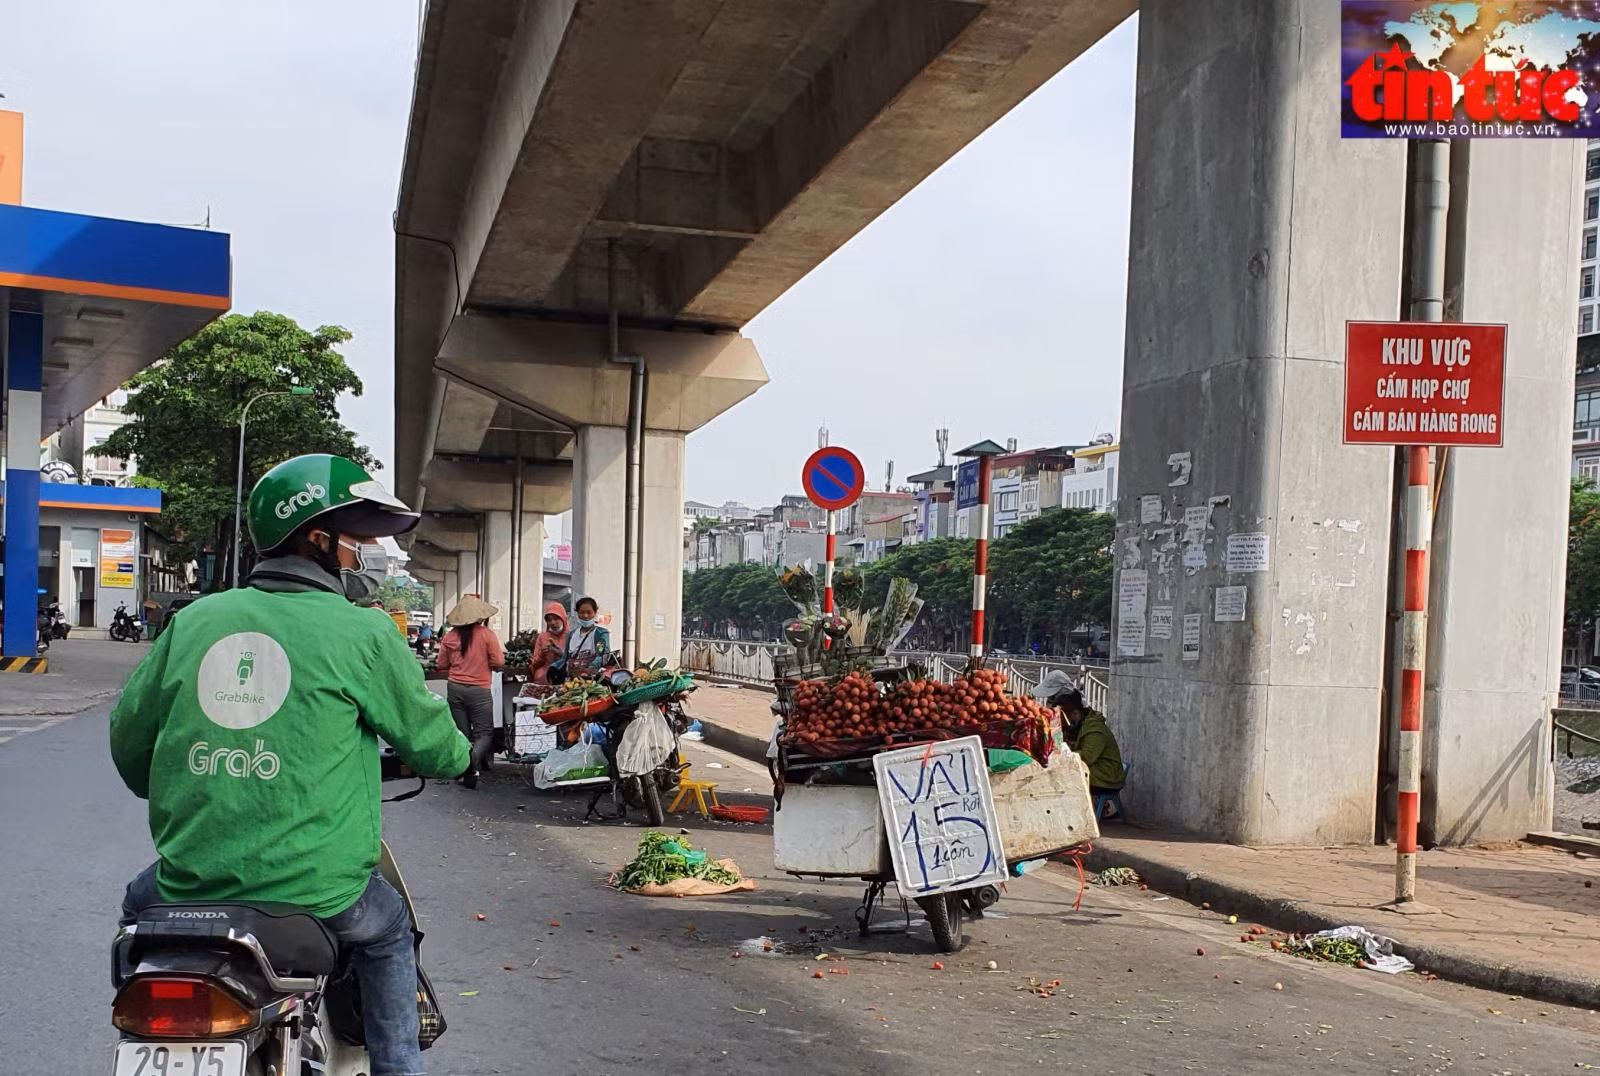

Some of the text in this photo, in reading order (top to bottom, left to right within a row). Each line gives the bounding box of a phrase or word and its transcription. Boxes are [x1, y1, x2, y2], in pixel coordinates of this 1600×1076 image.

[1382, 337, 1471, 372] KHU VỰC
[1377, 371, 1471, 405] CẤM HỌP CHỢ
[1353, 404, 1497, 434] CẤM BÁN HÀNG RONG
[275, 482, 326, 519] Grab
[215, 691, 265, 704] GrabBike
[188, 739, 280, 780] Grab
[901, 802, 992, 893] 15
[167, 911, 230, 919] HONDA
